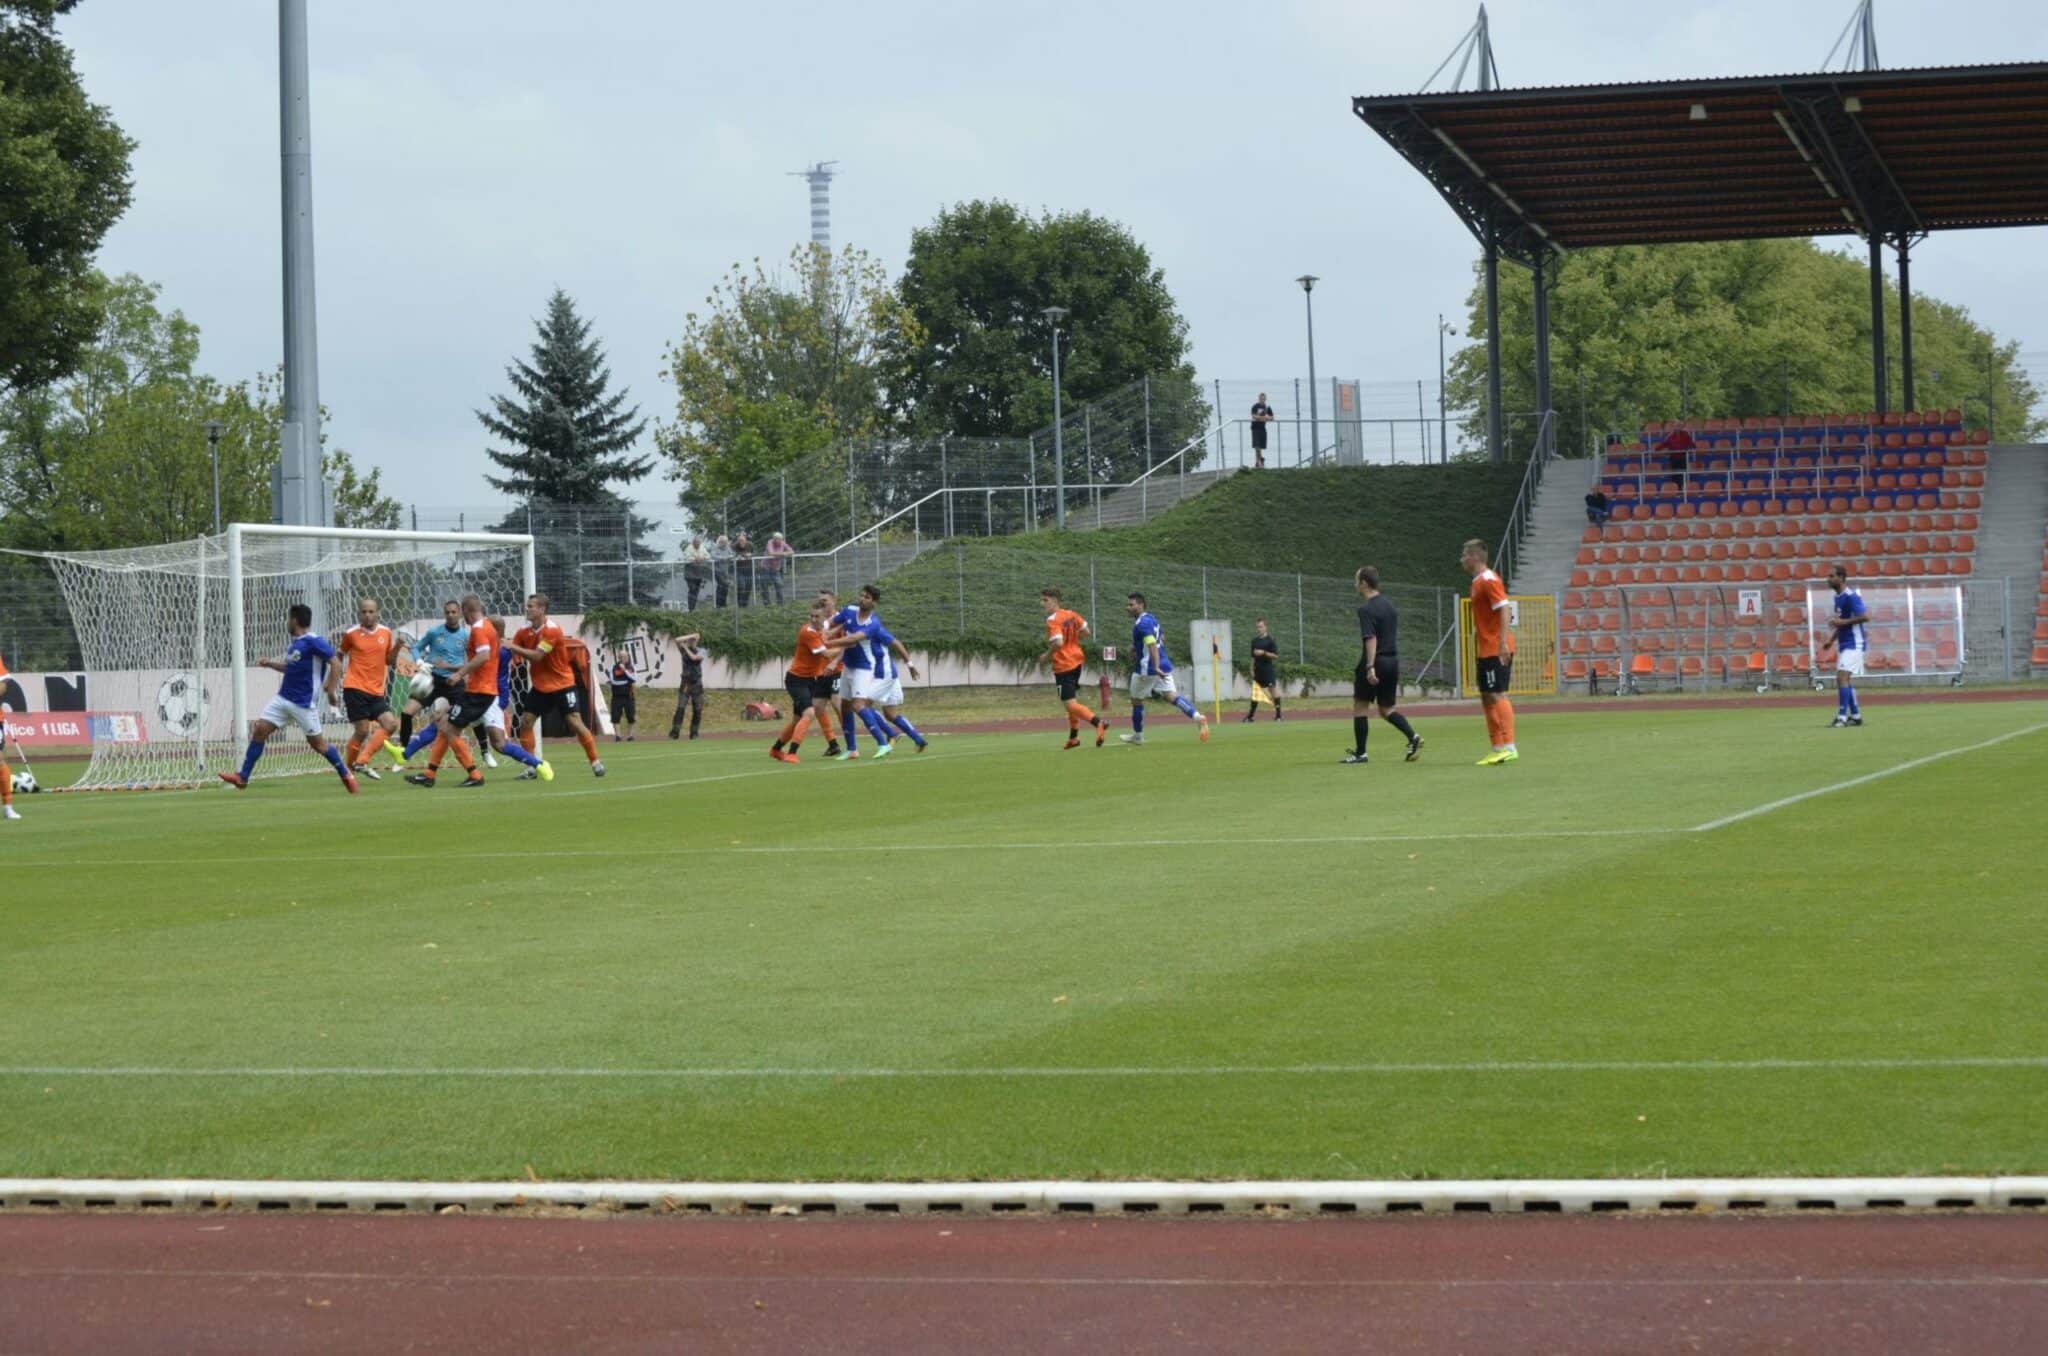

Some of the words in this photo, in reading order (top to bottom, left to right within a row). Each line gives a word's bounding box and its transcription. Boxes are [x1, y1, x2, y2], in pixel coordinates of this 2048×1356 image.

[1746, 598, 1755, 613] A
[3, 720, 35, 737] Nice
[50, 721, 80, 736] LIGA
